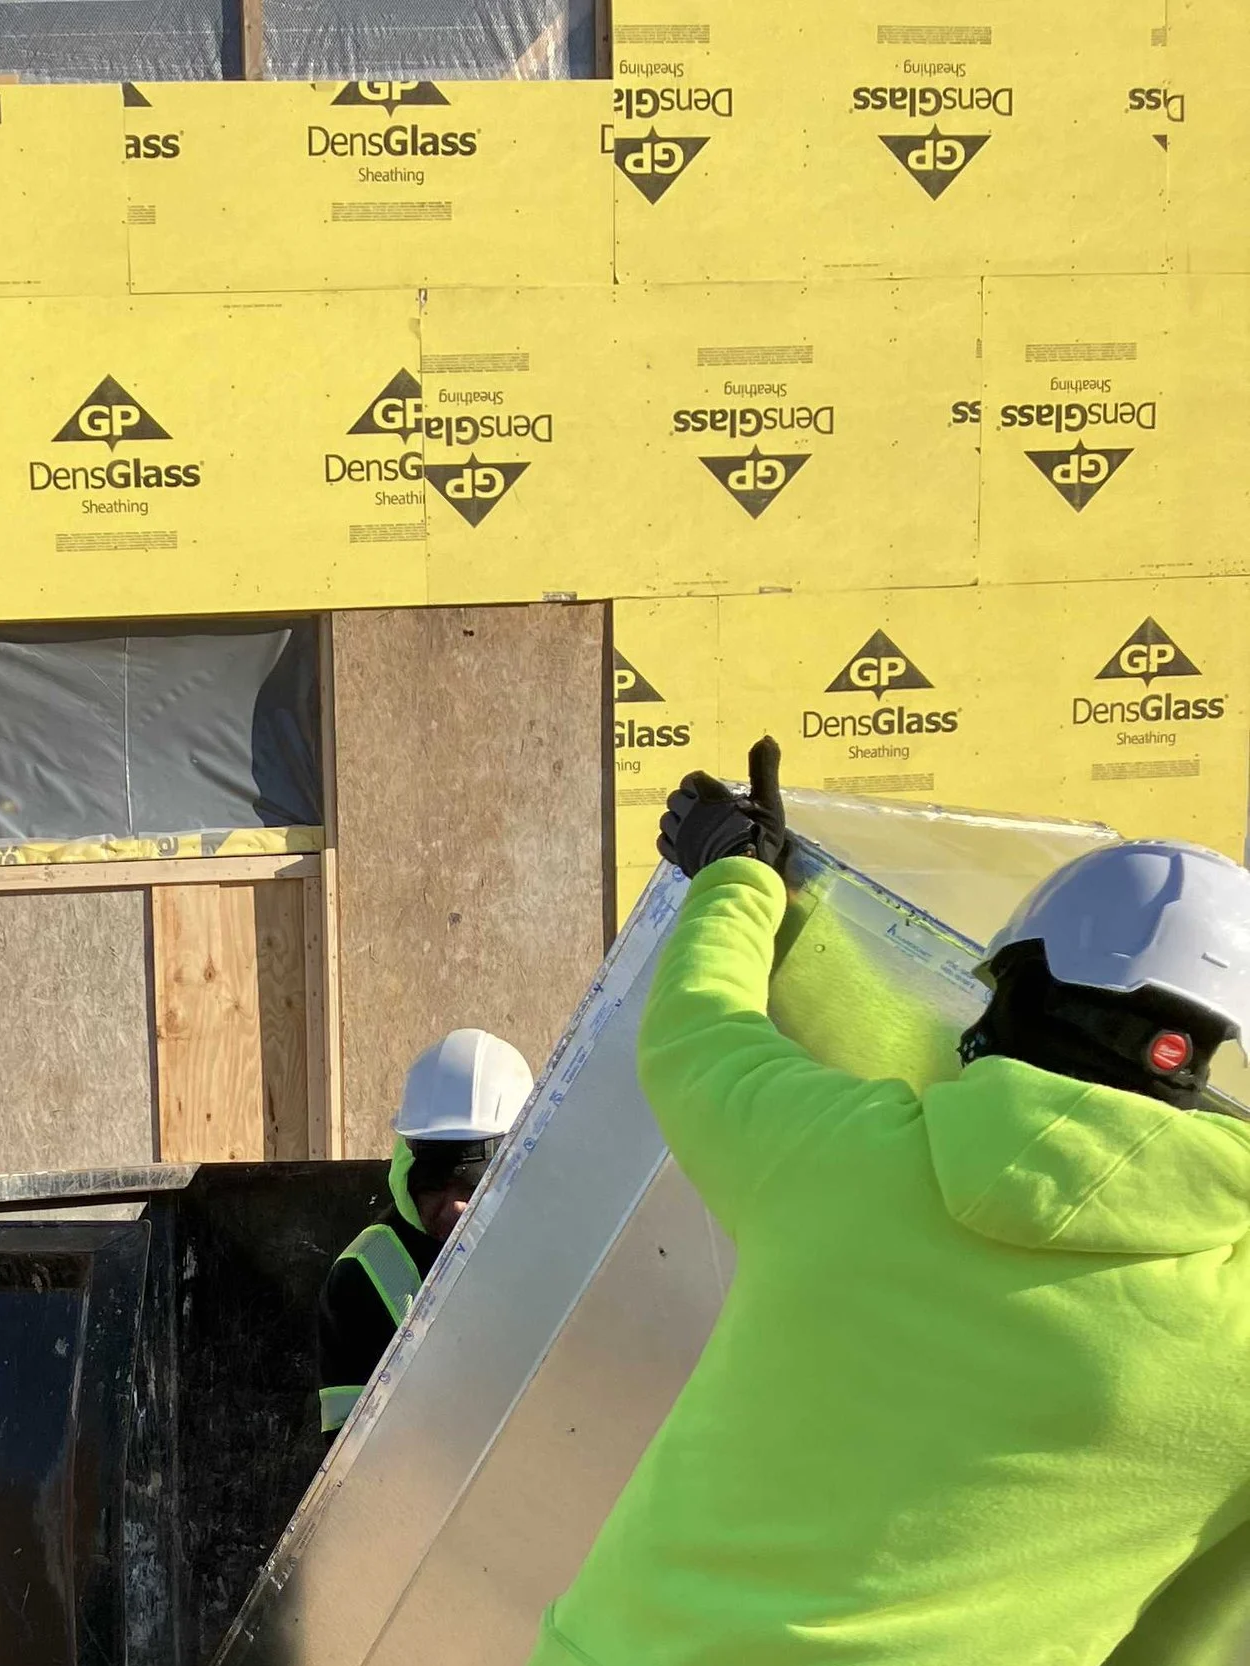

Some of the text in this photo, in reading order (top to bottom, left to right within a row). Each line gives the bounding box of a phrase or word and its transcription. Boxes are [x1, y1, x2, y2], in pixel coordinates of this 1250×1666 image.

[620, 60, 684, 78] Sheathing
[904, 60, 966, 77] Sheathing
[624, 141, 684, 174] GP
[907, 139, 966, 171] GP
[359, 167, 424, 185] Sheathing
[724, 381, 787, 398] Sheathing
[1051, 377, 1111, 394] Sheathing
[439, 389, 503, 406] Sheathing
[77, 404, 141, 438] GP
[726, 458, 787, 490] GP
[1052, 453, 1109, 484] GP
[445, 467, 505, 498] GP
[82, 499, 148, 516] Sheathing
[1119, 643, 1175, 674] GP
[848, 656, 907, 688] GP
[1116, 730, 1177, 747] Sheathing
[849, 744, 910, 762] Sheathing
